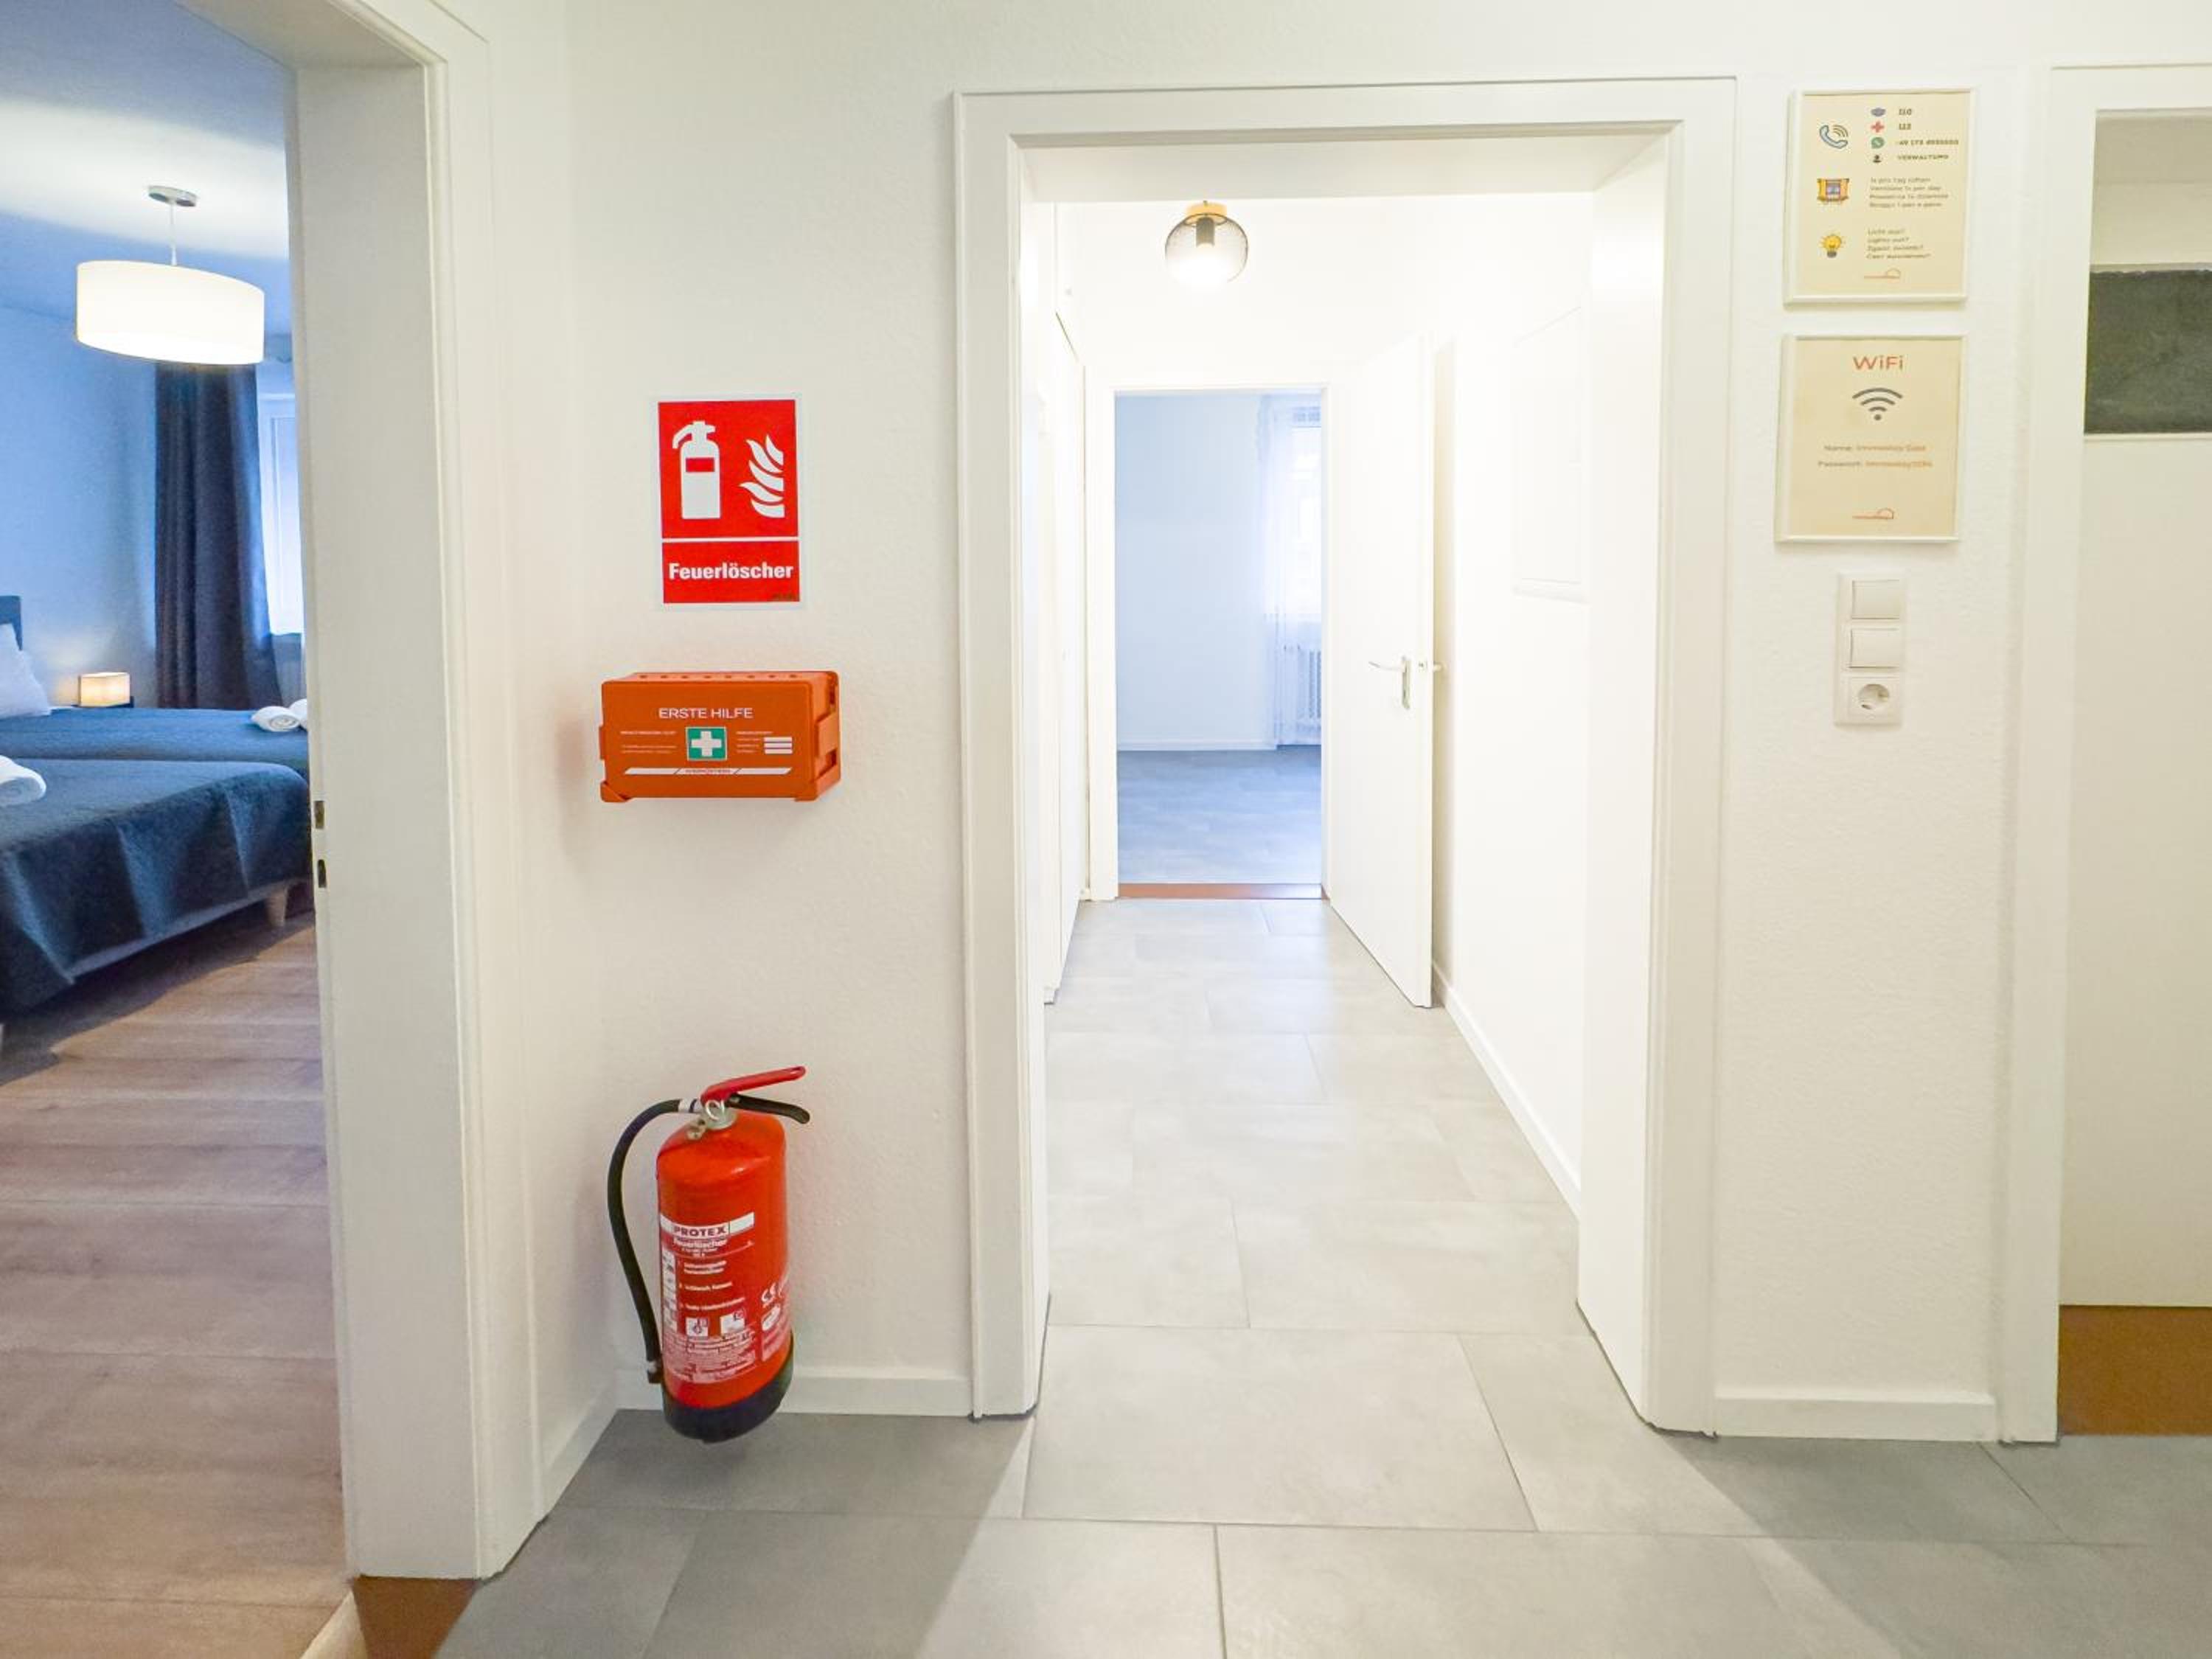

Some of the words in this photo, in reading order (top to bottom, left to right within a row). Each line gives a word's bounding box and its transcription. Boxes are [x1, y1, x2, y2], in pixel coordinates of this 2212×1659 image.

[1853, 355, 1904, 370] WiFi
[669, 561, 793, 580] Feuerlöscher
[658, 708, 707, 719] ERSTE
[711, 707, 754, 718] HILFE
[674, 1225, 726, 1237] PROTEX
